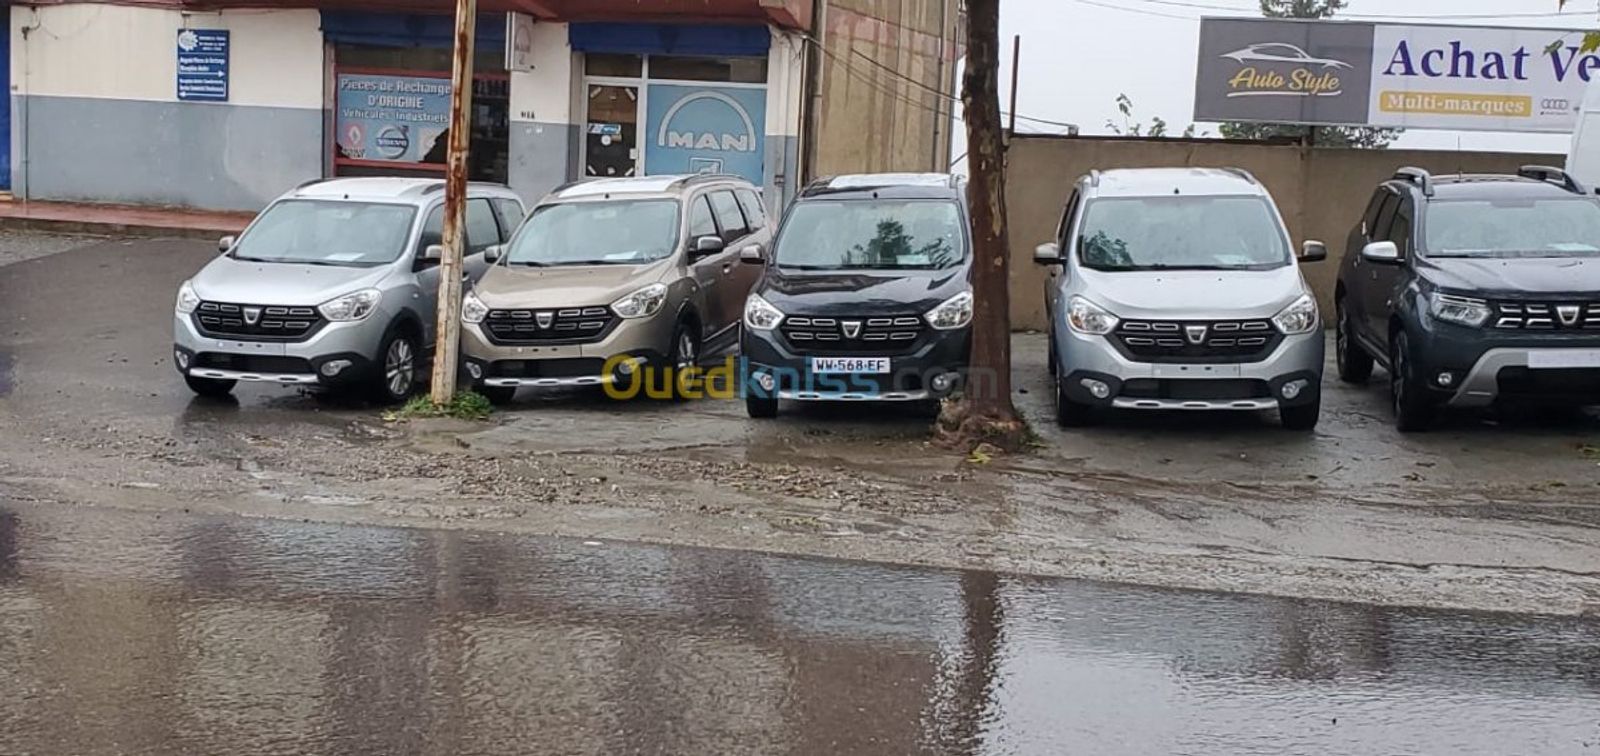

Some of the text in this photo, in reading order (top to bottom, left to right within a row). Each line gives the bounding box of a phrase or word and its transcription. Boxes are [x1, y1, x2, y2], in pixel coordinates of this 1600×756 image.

[1383, 40, 1530, 80] Achat
[380, 80, 394, 92] de
[397, 80, 452, 96] Rechange
[1229, 67, 1340, 95] Auto Style
[368, 94, 424, 109] D'ORIGINE
[1387, 94, 1525, 115] Multi-marques
[378, 138, 407, 147] VOLVO
[668, 131, 748, 151] MAN
